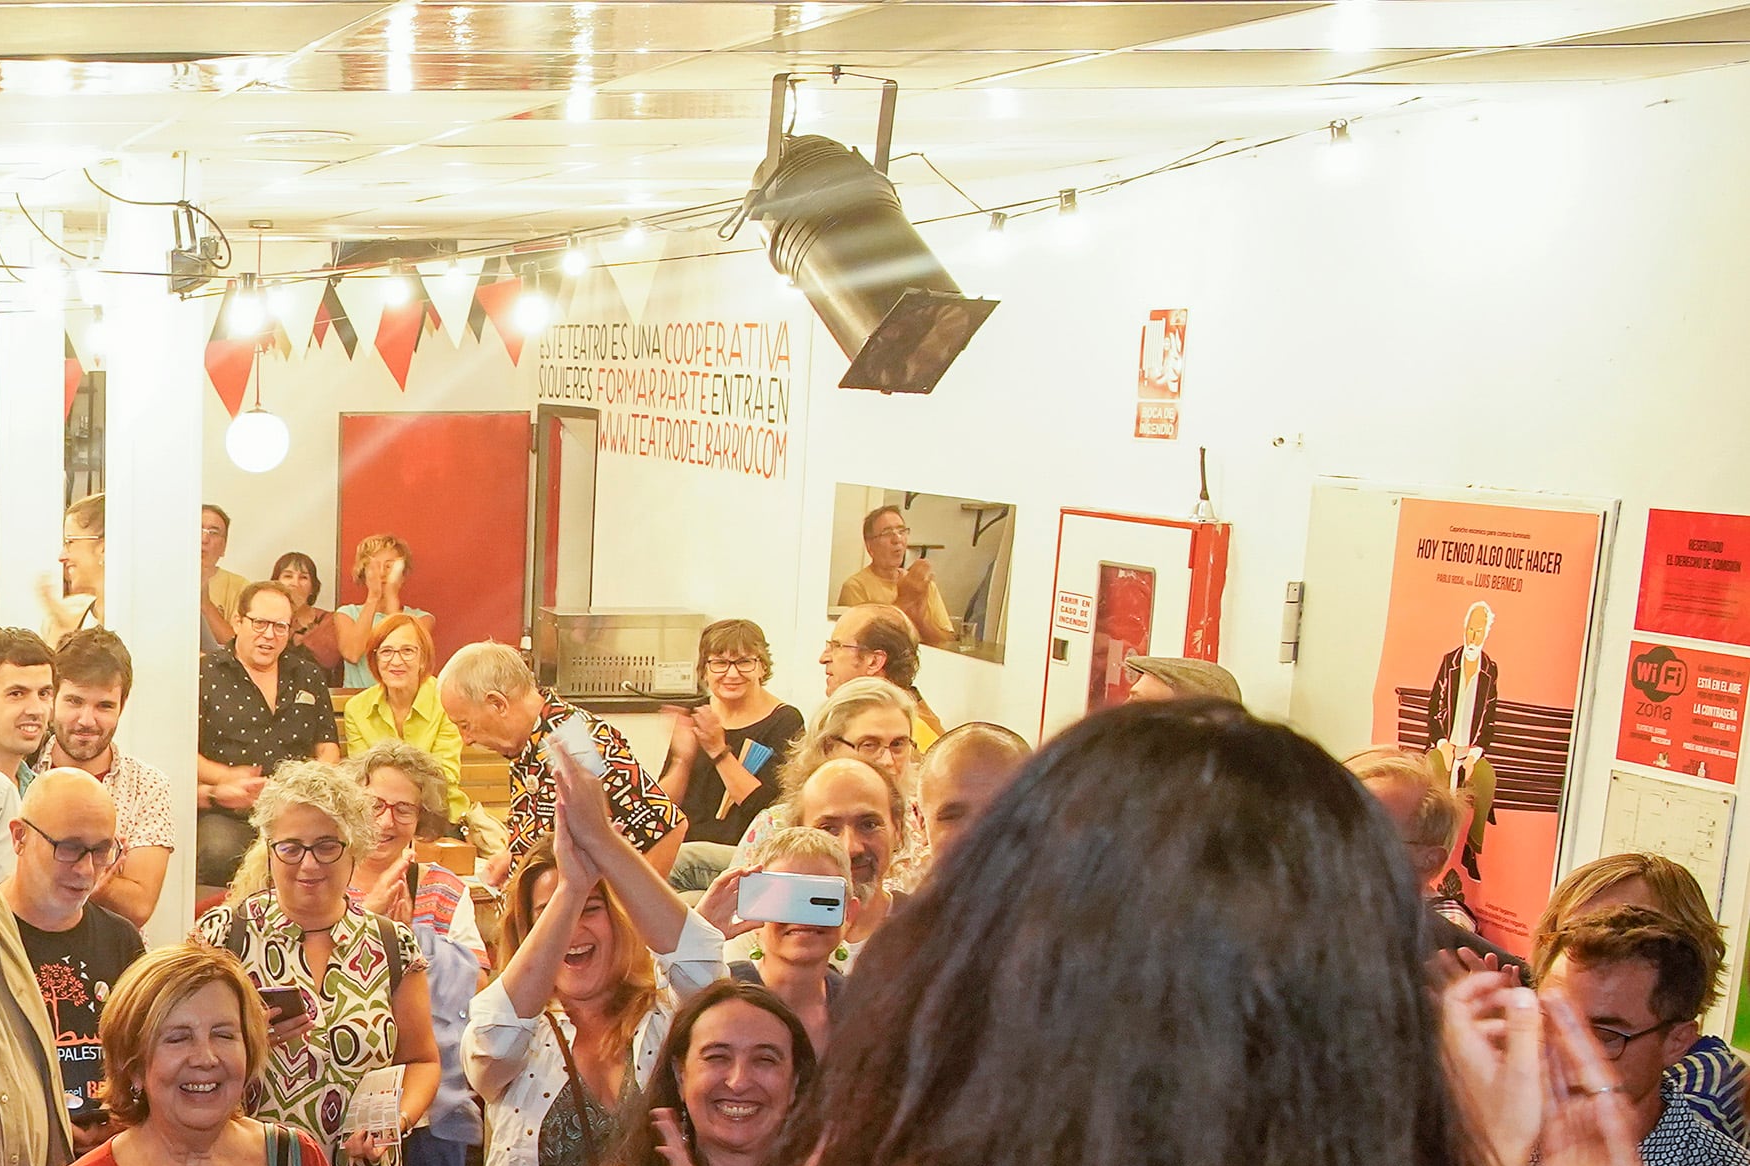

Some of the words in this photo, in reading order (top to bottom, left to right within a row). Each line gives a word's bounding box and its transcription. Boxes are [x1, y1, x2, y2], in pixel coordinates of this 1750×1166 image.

[540, 324, 565, 359] ESTE
[567, 323, 608, 360] TEATRO
[611, 323, 628, 360] ES
[632, 324, 662, 360] UNA
[664, 321, 790, 372] COOPERATIVA
[538, 364, 547, 399] SI
[547, 364, 593, 402] QUIERES
[597, 367, 656, 409] FORMAR
[659, 368, 709, 415] PARTE
[711, 374, 765, 421] ENTRA
[767, 377, 790, 425] EN
[1139, 421, 1174, 436] INCENDIO
[599, 410, 788, 480] WWW.TEATRODELBARRIO.COM
[1417, 538, 1440, 559] HOY
[1441, 540, 1475, 564] TENGO
[1475, 543, 1503, 567] ALGO
[1505, 547, 1525, 570] QUE
[1525, 550, 1563, 575] HACER
[1474, 573, 1490, 589] LUIS
[1491, 575, 1523, 593] BERMEJO
[1080, 608, 1089, 618] DE
[1081, 599, 1091, 609] EN
[1058, 615, 1088, 629] INCENDIO
[1635, 702, 1672, 721] zona
[1693, 703, 1701, 715] LA
